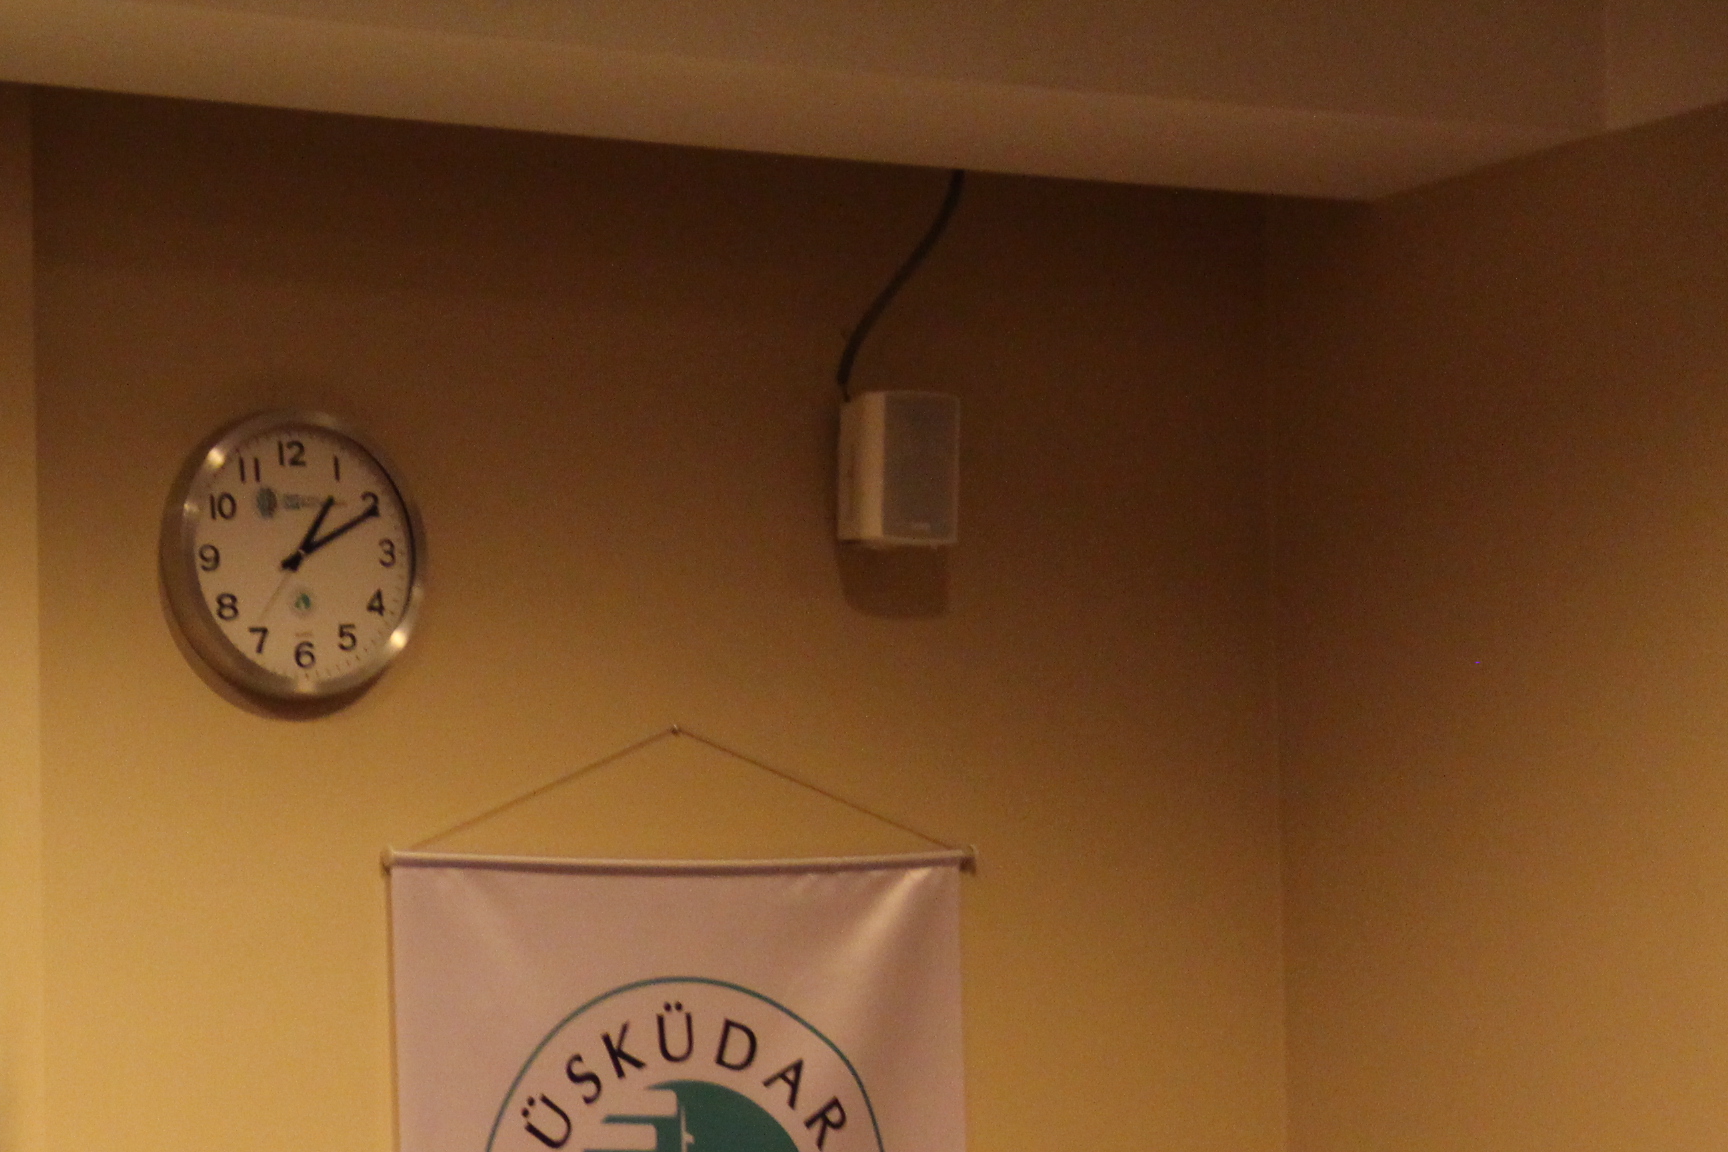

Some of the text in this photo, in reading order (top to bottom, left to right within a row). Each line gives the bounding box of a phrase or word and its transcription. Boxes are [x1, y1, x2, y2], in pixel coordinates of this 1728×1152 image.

[277, 441, 305, 467] 12
[239, 456, 261, 483] 11
[333, 456, 341, 482] 1
[209, 492, 237, 520] 10
[198, 544, 220, 571] 9
[378, 538, 396, 568] 3
[215, 593, 239, 621] 8
[366, 588, 385, 616] 4
[248, 626, 268, 653] 7
[337, 624, 357, 651] 5
[294, 641, 316, 669] 6
[521, 1001, 848, 1152] ÜSKÜDAR
